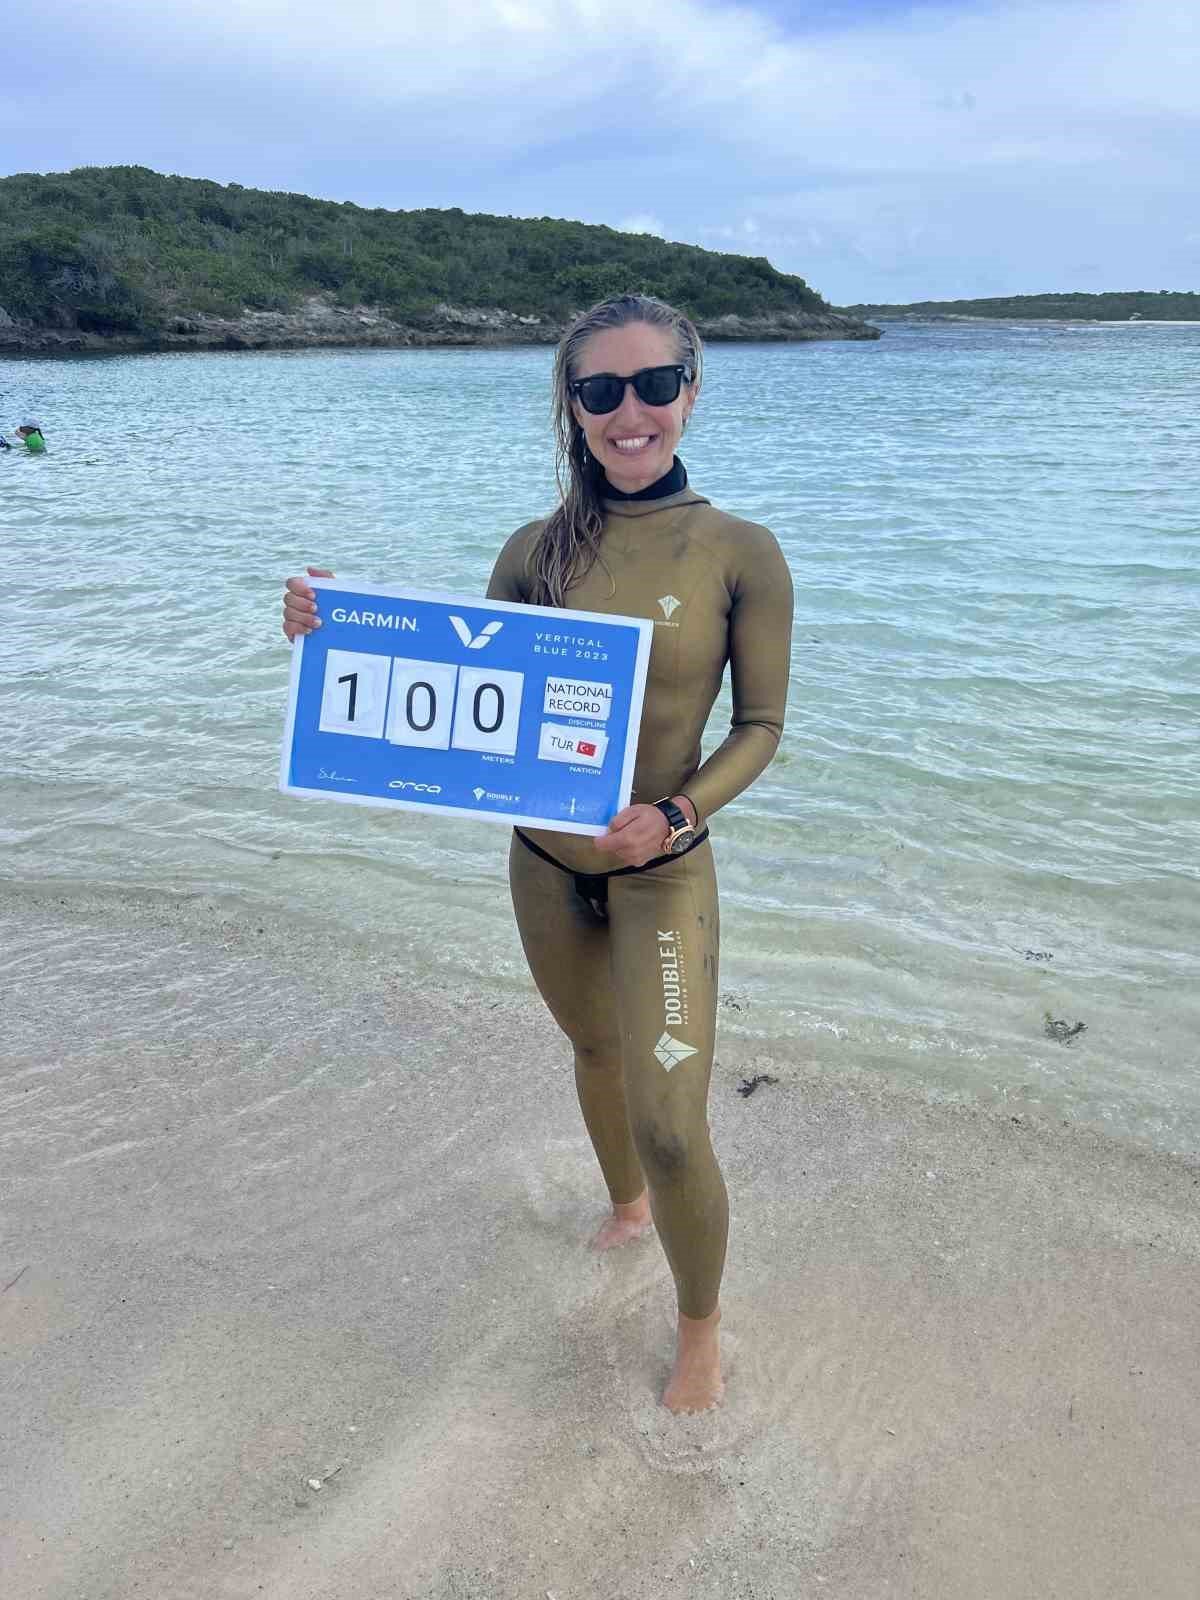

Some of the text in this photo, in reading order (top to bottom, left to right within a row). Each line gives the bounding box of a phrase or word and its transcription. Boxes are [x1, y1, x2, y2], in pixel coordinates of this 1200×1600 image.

[535, 632, 604, 648] VERTICAL
[534, 644, 609, 661] BLUE 2023
[547, 682, 614, 699] NATIONAL
[548, 698, 601, 713] RECORD
[568, 718, 607, 729] DISCIPLINE
[550, 735, 574, 752] TUR
[481, 754, 515, 765] METERS
[569, 765, 601, 776] NATION
[388, 780, 442, 795] orca
[657, 930, 682, 1025] DOUBLE K
